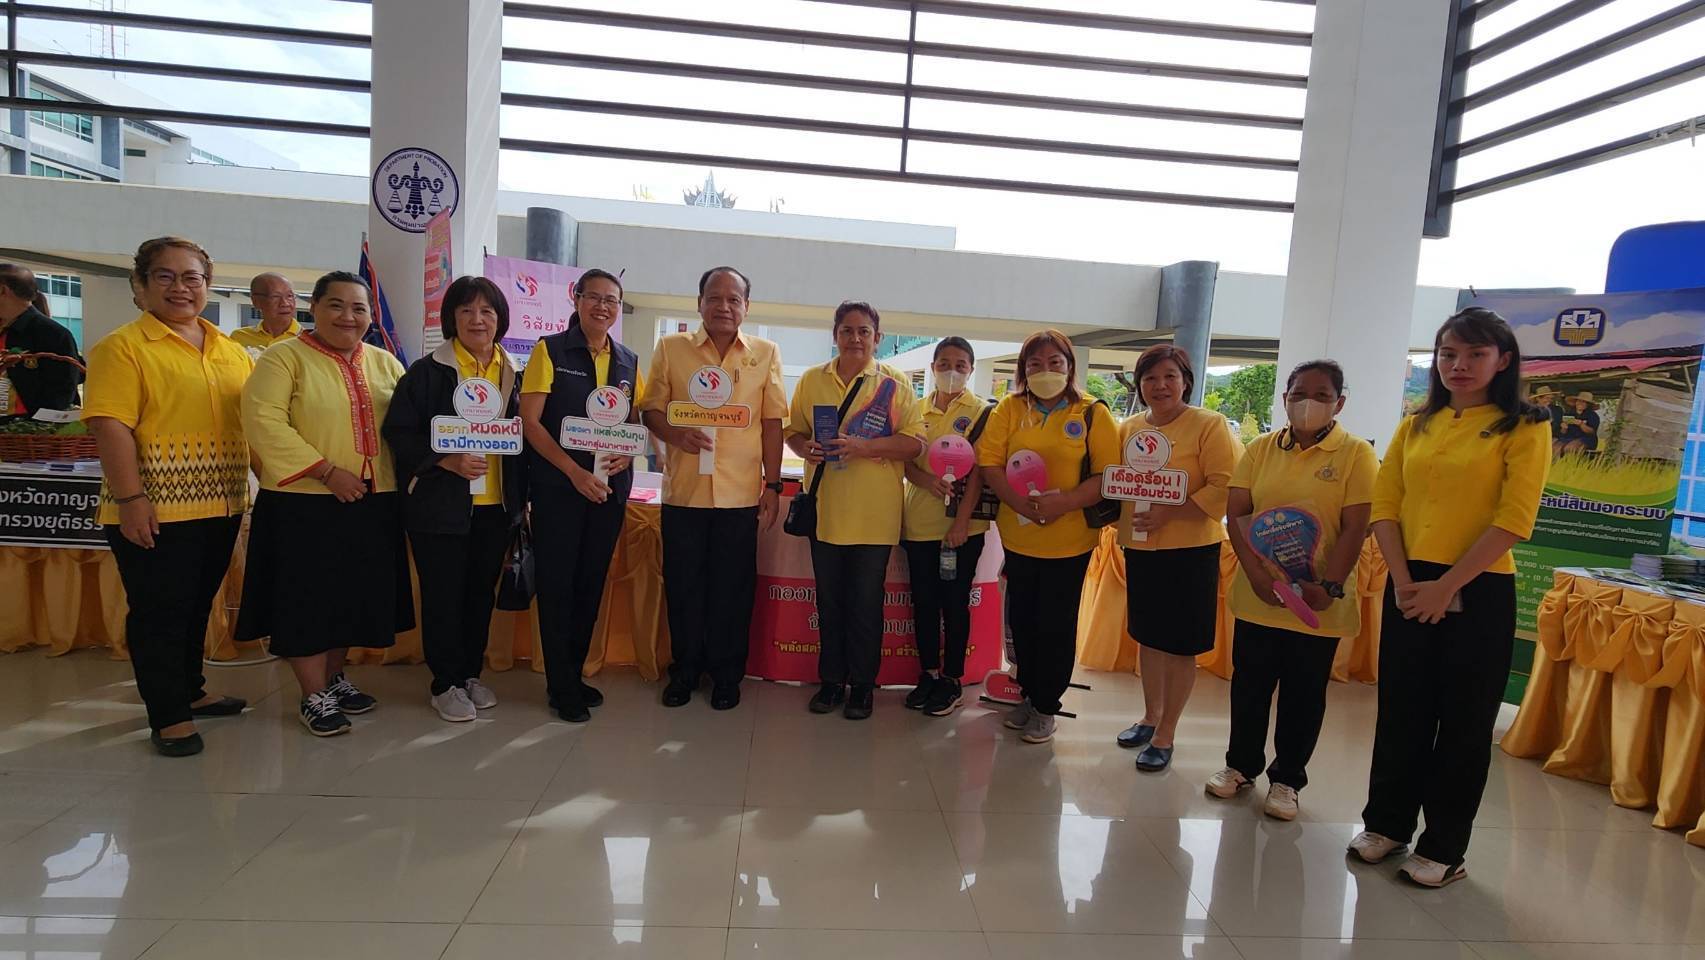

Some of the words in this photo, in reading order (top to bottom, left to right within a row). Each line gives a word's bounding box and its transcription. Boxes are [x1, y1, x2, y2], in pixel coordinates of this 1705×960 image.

[384, 153, 415, 172] DEPARTMENT
[424, 155, 448, 178] PROBATION
[522, 314, 566, 332] วิสัยทั
[673, 409, 742, 423] จังหวัดกาญจนบุรี
[438, 436, 518, 450] เรามีทางออก
[593, 426, 645, 442] แหล่งเงินทุน
[1111, 468, 1172, 487] เดือดร้อน
[0, 486, 100, 511] งหวัดกาญจ
[1107, 484, 1181, 500] เราพร้อมช่วย
[1540, 492, 1667, 520] ะหนี้สินนอกระบบ
